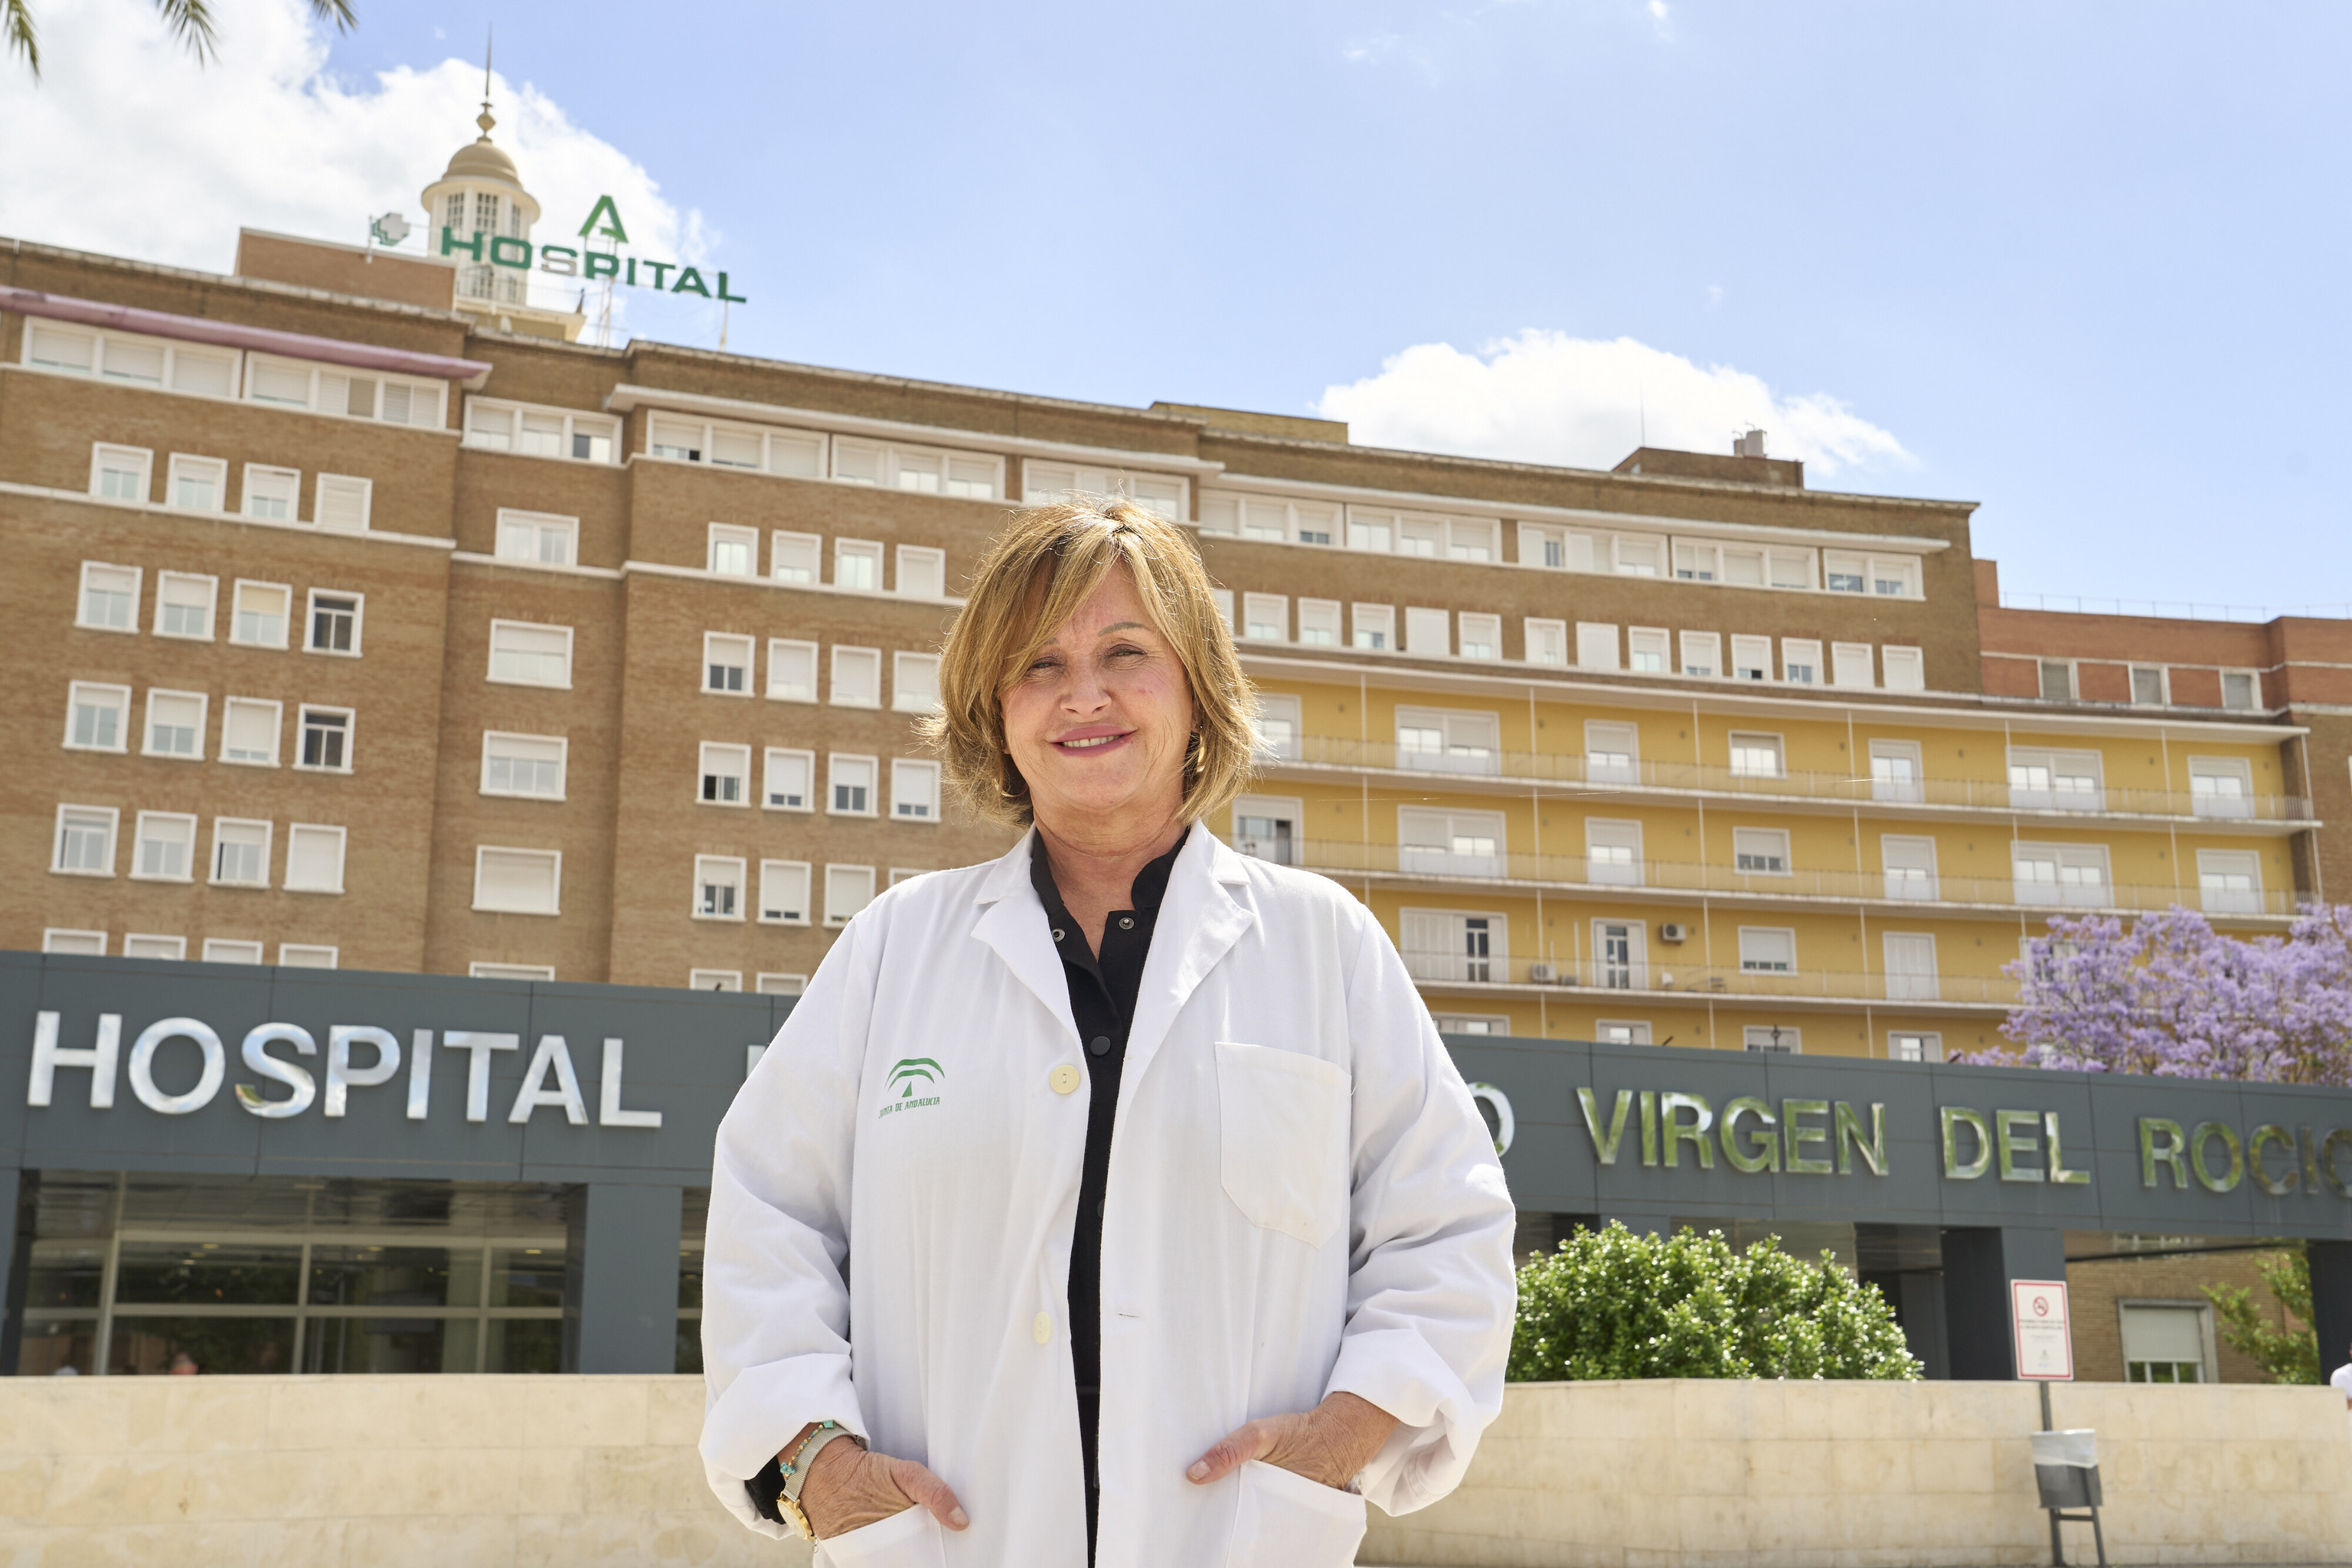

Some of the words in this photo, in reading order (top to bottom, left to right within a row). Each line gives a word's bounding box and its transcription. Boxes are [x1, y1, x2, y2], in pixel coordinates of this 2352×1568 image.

[441, 227, 746, 304] HOSPITAL
[27, 1011, 662, 1128] HOSPITAL
[1576, 1087, 1889, 1176] VIRGEN
[1940, 1106, 2090, 1184] DEL
[878, 1105, 893, 1119] JUNTA
[895, 1102, 903, 1112] DE
[905, 1096, 940, 1109] ANDALUCIA
